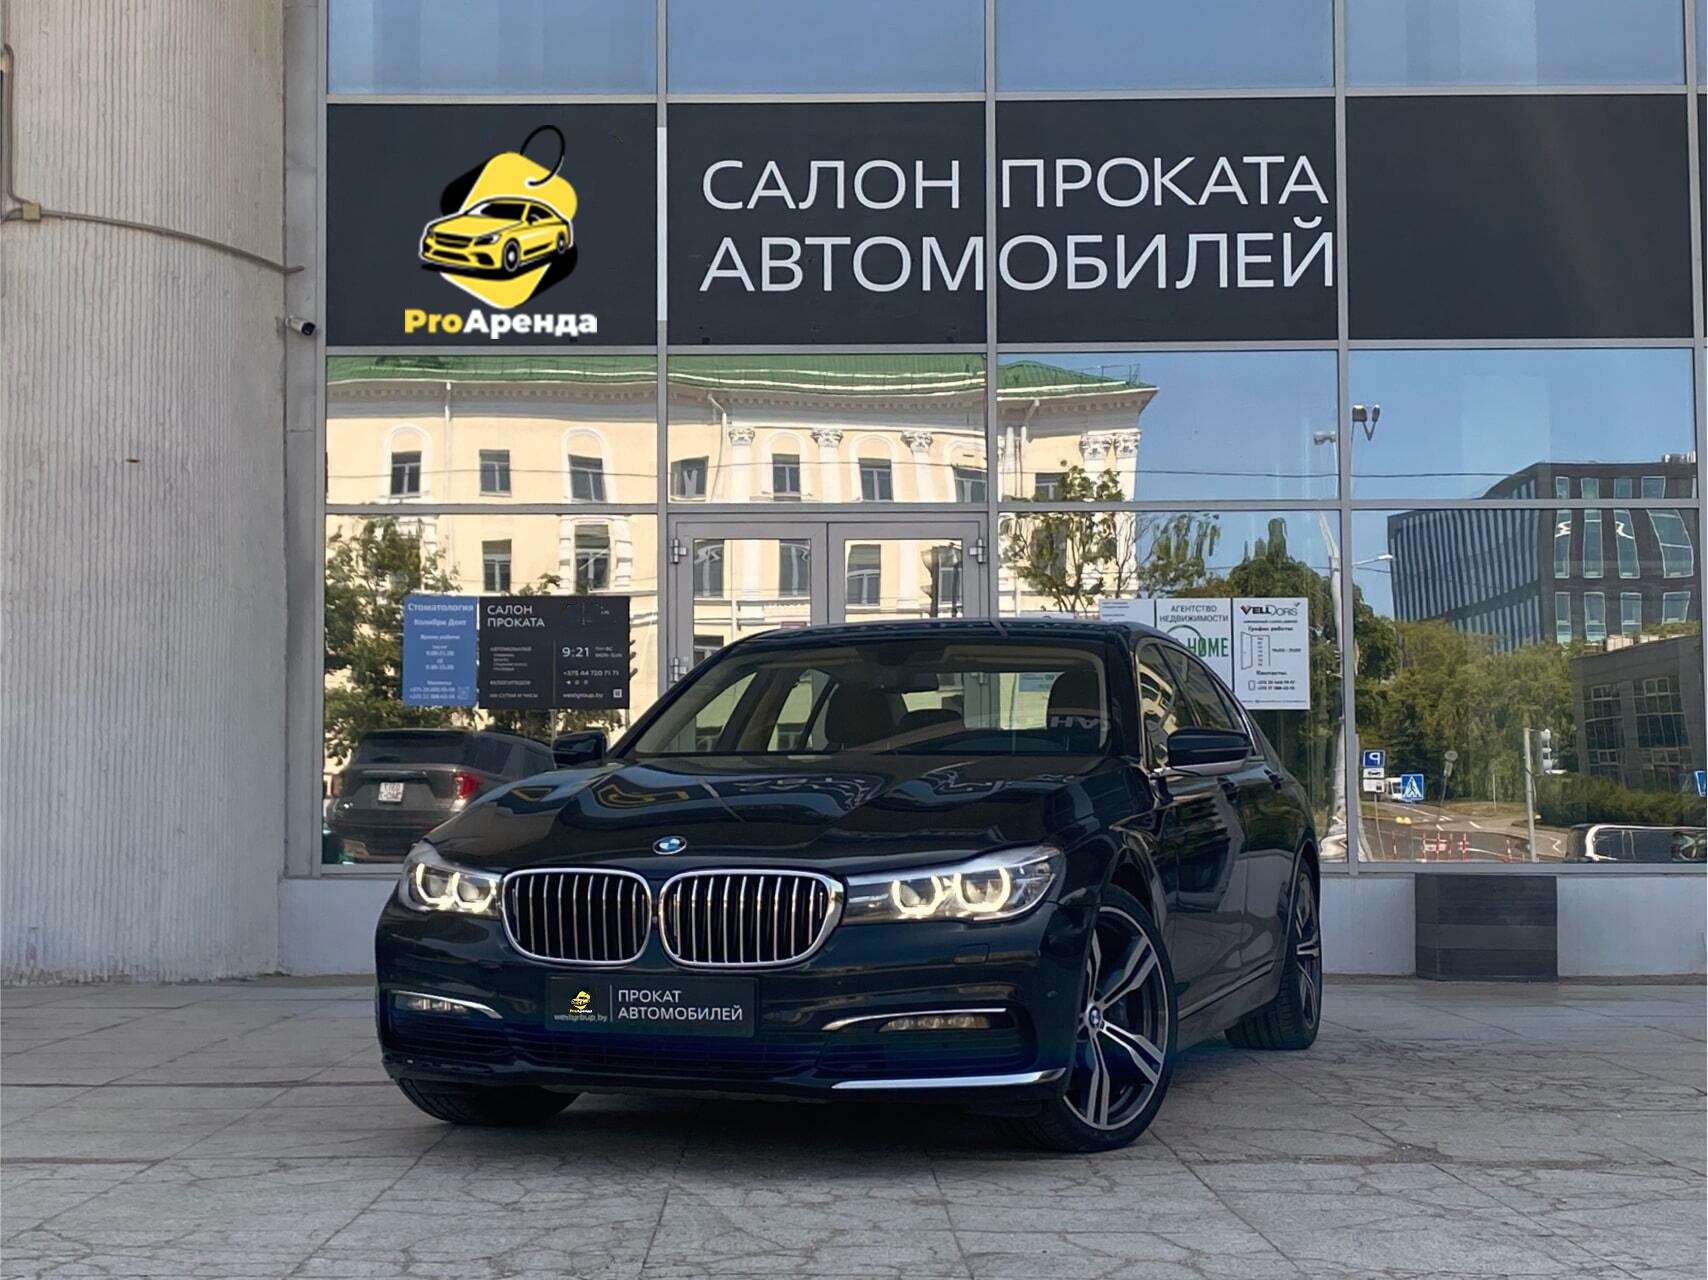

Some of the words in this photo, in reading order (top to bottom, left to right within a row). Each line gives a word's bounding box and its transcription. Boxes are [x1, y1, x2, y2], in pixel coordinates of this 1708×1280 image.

[702, 159, 960, 210] САЛОН
[1002, 155, 1329, 208] ПРОКАТА
[699, 216, 1334, 293] АВТОМОБИЛЕЙ
[404, 308, 598, 339] ProАренда
[487, 604, 533, 615] САЛОН
[1170, 604, 1218, 613] АГЕНТСТВО
[487, 617, 545, 628] ПРОКАТА
[1159, 615, 1229, 624] НЕДВИЖИМОСТИ
[561, 646, 590, 658] 9:21
[1187, 637, 1229, 657] HOME
[618, 990, 682, 1003] ПРОКАТ
[617, 1004, 743, 1021] АВТОМОБИЛЕЙ
